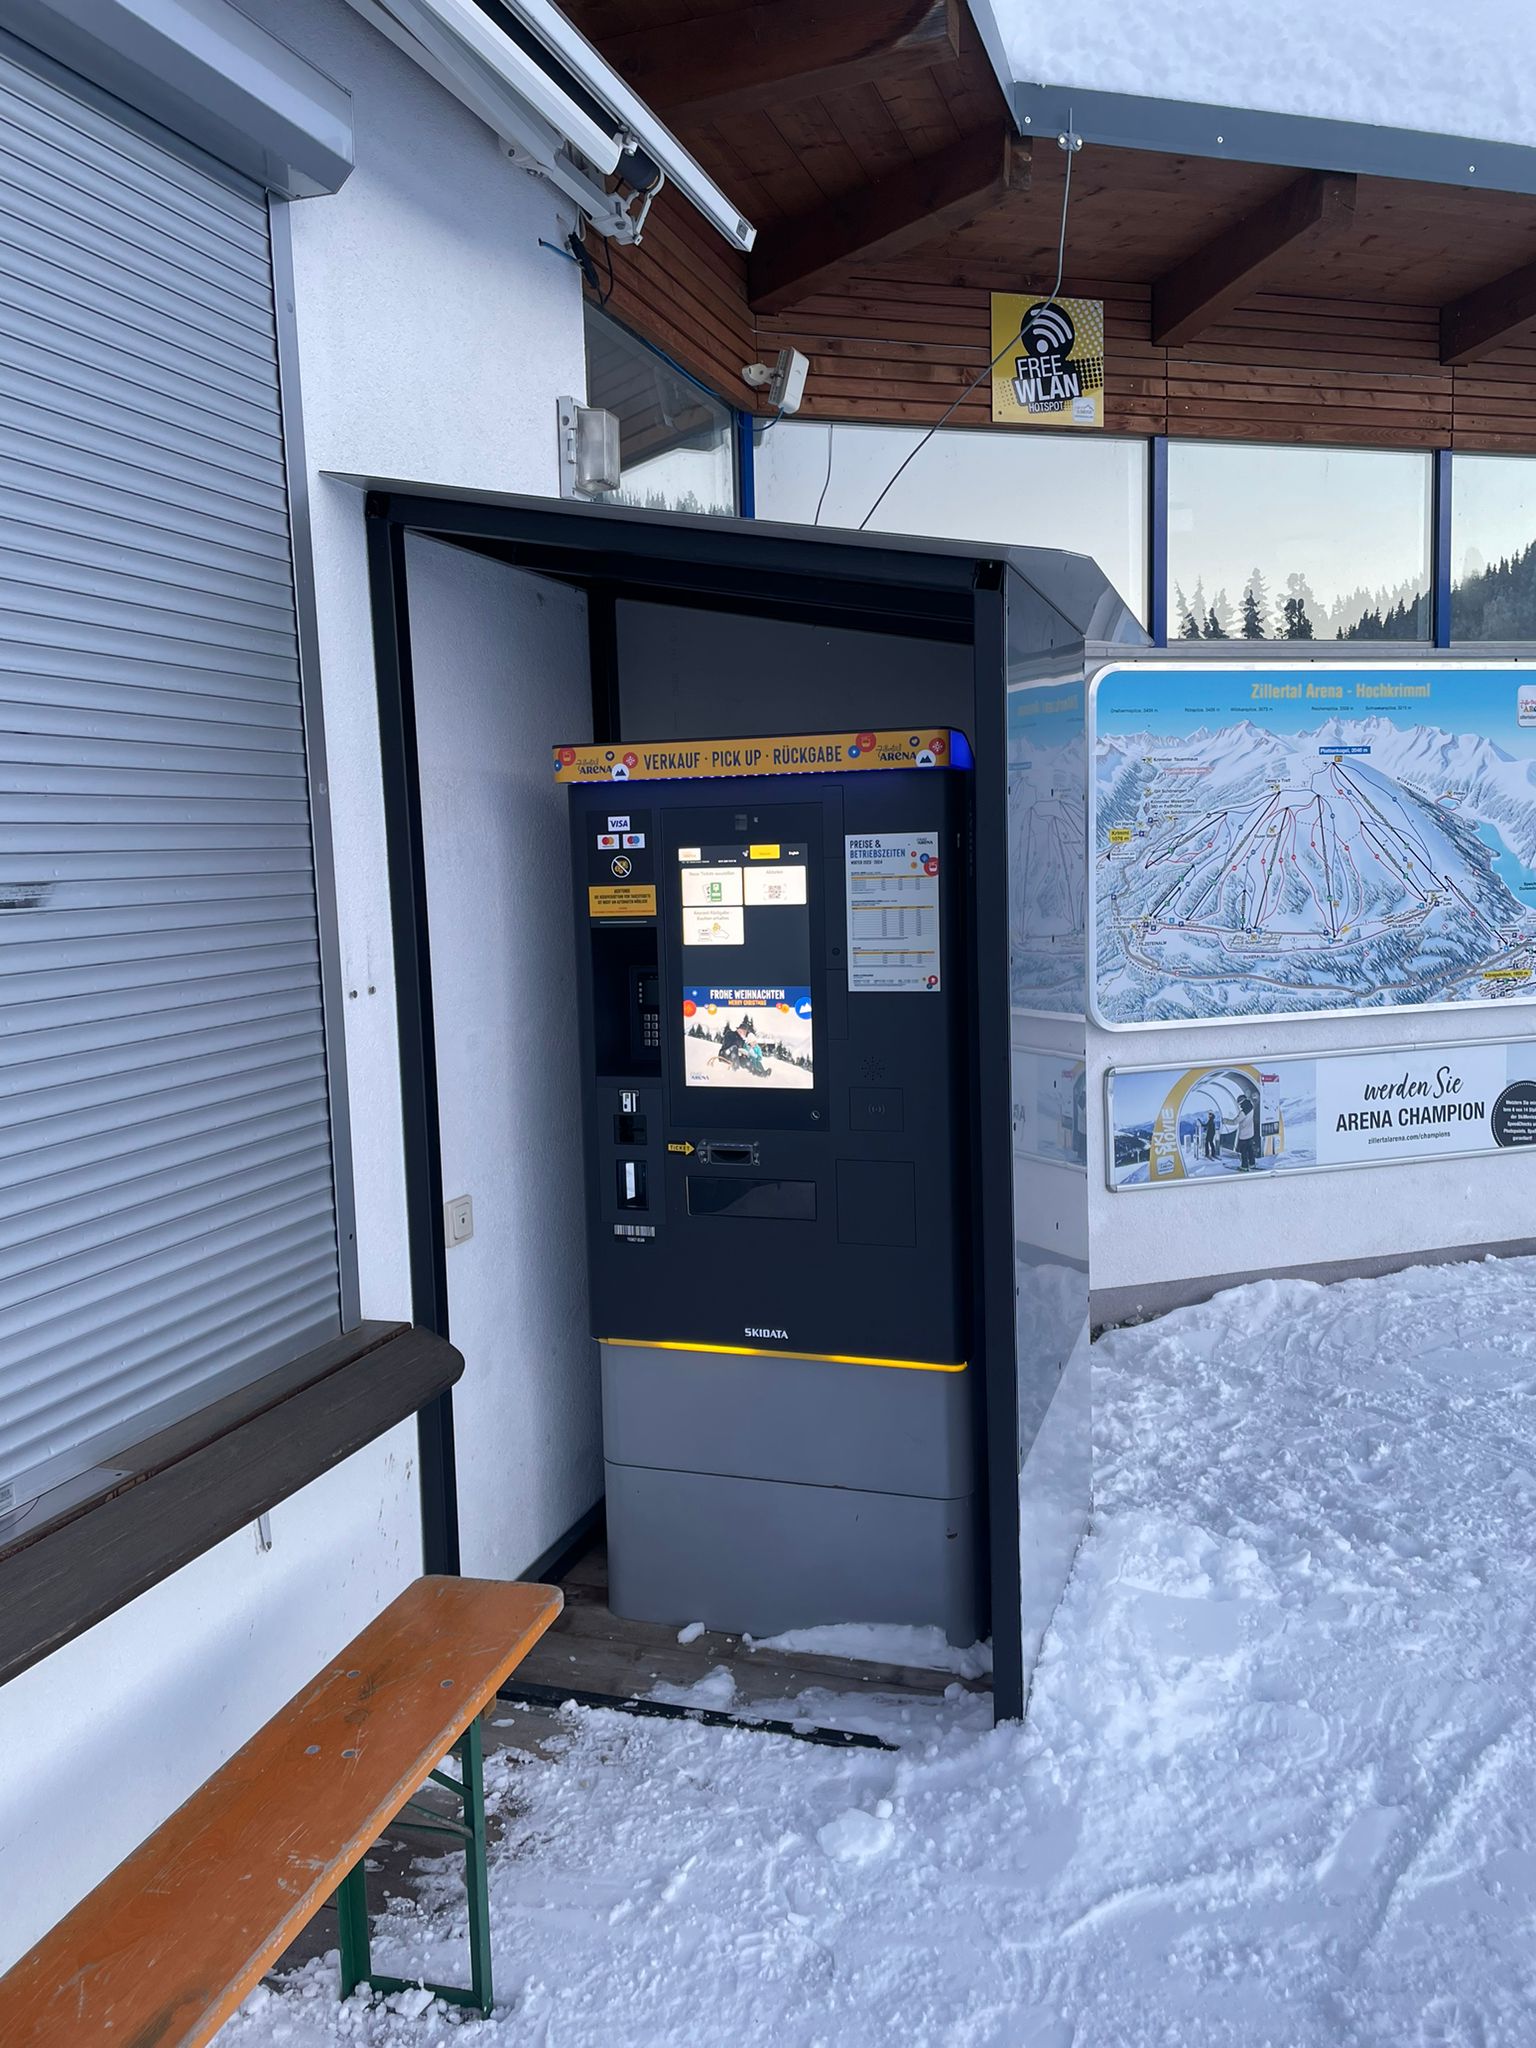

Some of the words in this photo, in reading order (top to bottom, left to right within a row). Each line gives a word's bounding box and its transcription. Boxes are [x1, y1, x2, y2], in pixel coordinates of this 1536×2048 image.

[1017, 354, 1064, 380] FREE
[1014, 373, 1080, 404] WLAN
[1028, 401, 1064, 413] HOTSPOT
[1251, 683, 1302, 699] Zillertal
[1306, 683, 1343, 699] Arena
[1356, 682, 1431, 698] Hochkrimml
[643, 752, 701, 771] VERKAUF
[711, 750, 741, 767] PICK
[745, 749, 762, 766] UP
[773, 745, 843, 765] RÜCKGABE
[610, 820, 629, 828] VISA
[849, 840, 873, 849] PREISE
[874, 839, 881, 848] &
[850, 848, 906, 859] BETRIEBSZEITEN
[710, 989, 733, 1000] FROHE
[734, 989, 785, 1000] WEIHNACHTEN
[1364, 1072, 1432, 1101] werden
[1433, 1065, 1464, 1099] Sie
[1335, 1109, 1393, 1132] ARENA
[1398, 1101, 1485, 1126] CHAMPION
[1162, 1108, 1178, 1153] MOVIE
[1368, 1130, 1451, 1145] zillertalarena.com/champions
[1153, 1132, 1167, 1156] SKI
[744, 1327, 789, 1340] SKIDATA
